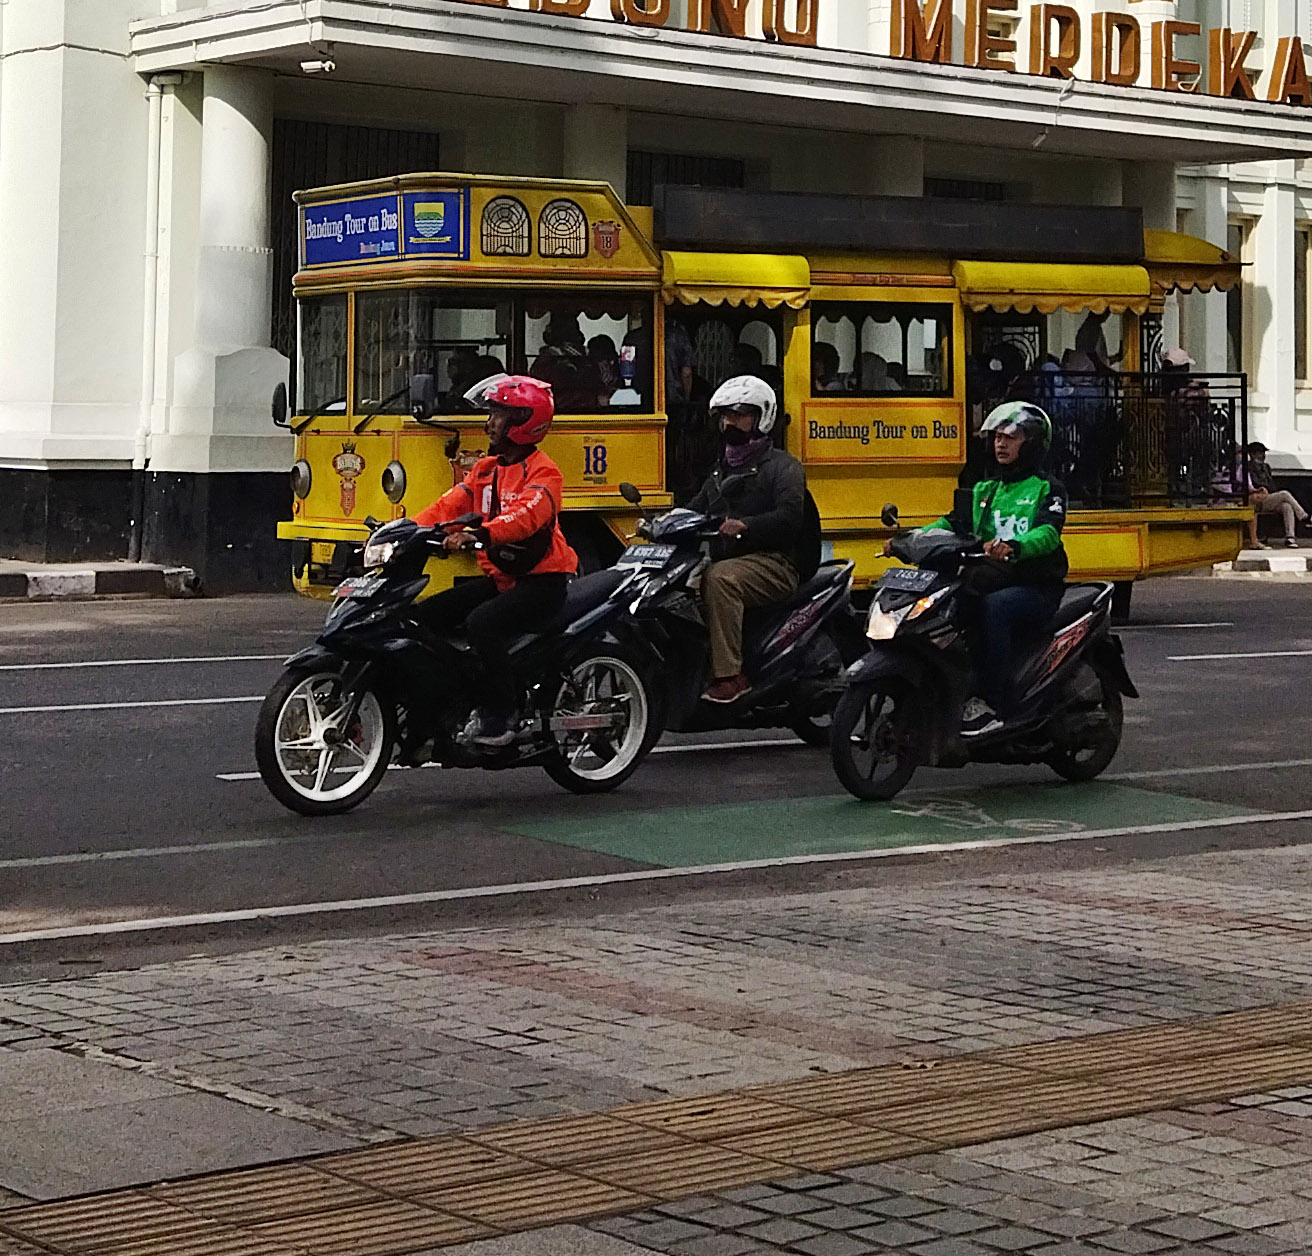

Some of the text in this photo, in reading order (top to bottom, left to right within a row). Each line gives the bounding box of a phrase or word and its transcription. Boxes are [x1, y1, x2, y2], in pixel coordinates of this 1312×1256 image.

[305, 208, 398, 243] Bandung Tour on Bus
[601, 235, 612, 249] 18
[808, 419, 958, 445] Bandung Tour on Bus
[583, 445, 608, 475] 18
